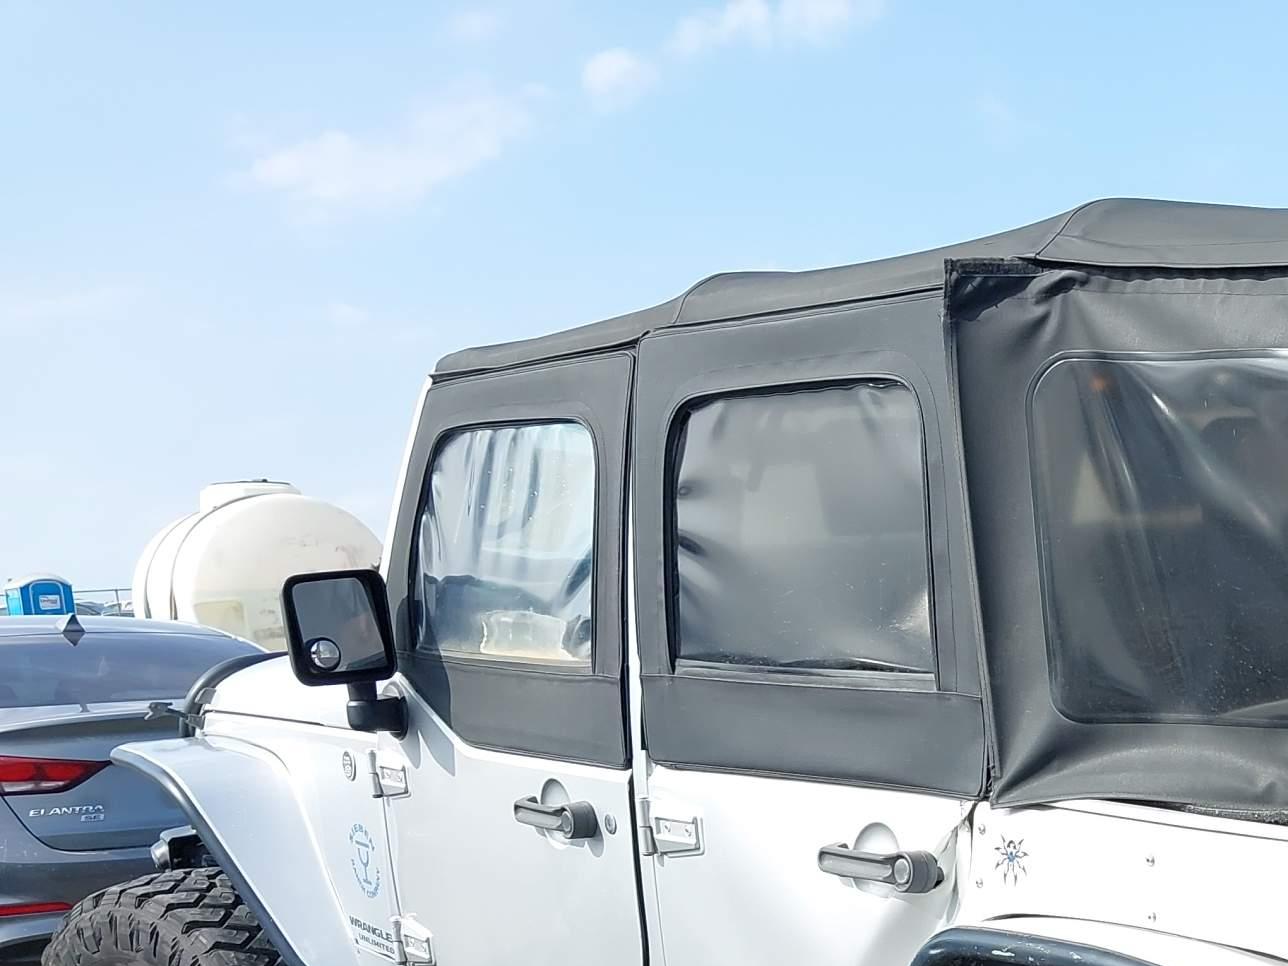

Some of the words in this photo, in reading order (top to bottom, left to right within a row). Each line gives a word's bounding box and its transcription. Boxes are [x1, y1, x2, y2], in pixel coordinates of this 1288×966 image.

[28, 804, 105, 817] ELANTRA
[348, 914, 394, 943] WRANGLE
[358, 932, 395, 954] UNLIMITED
